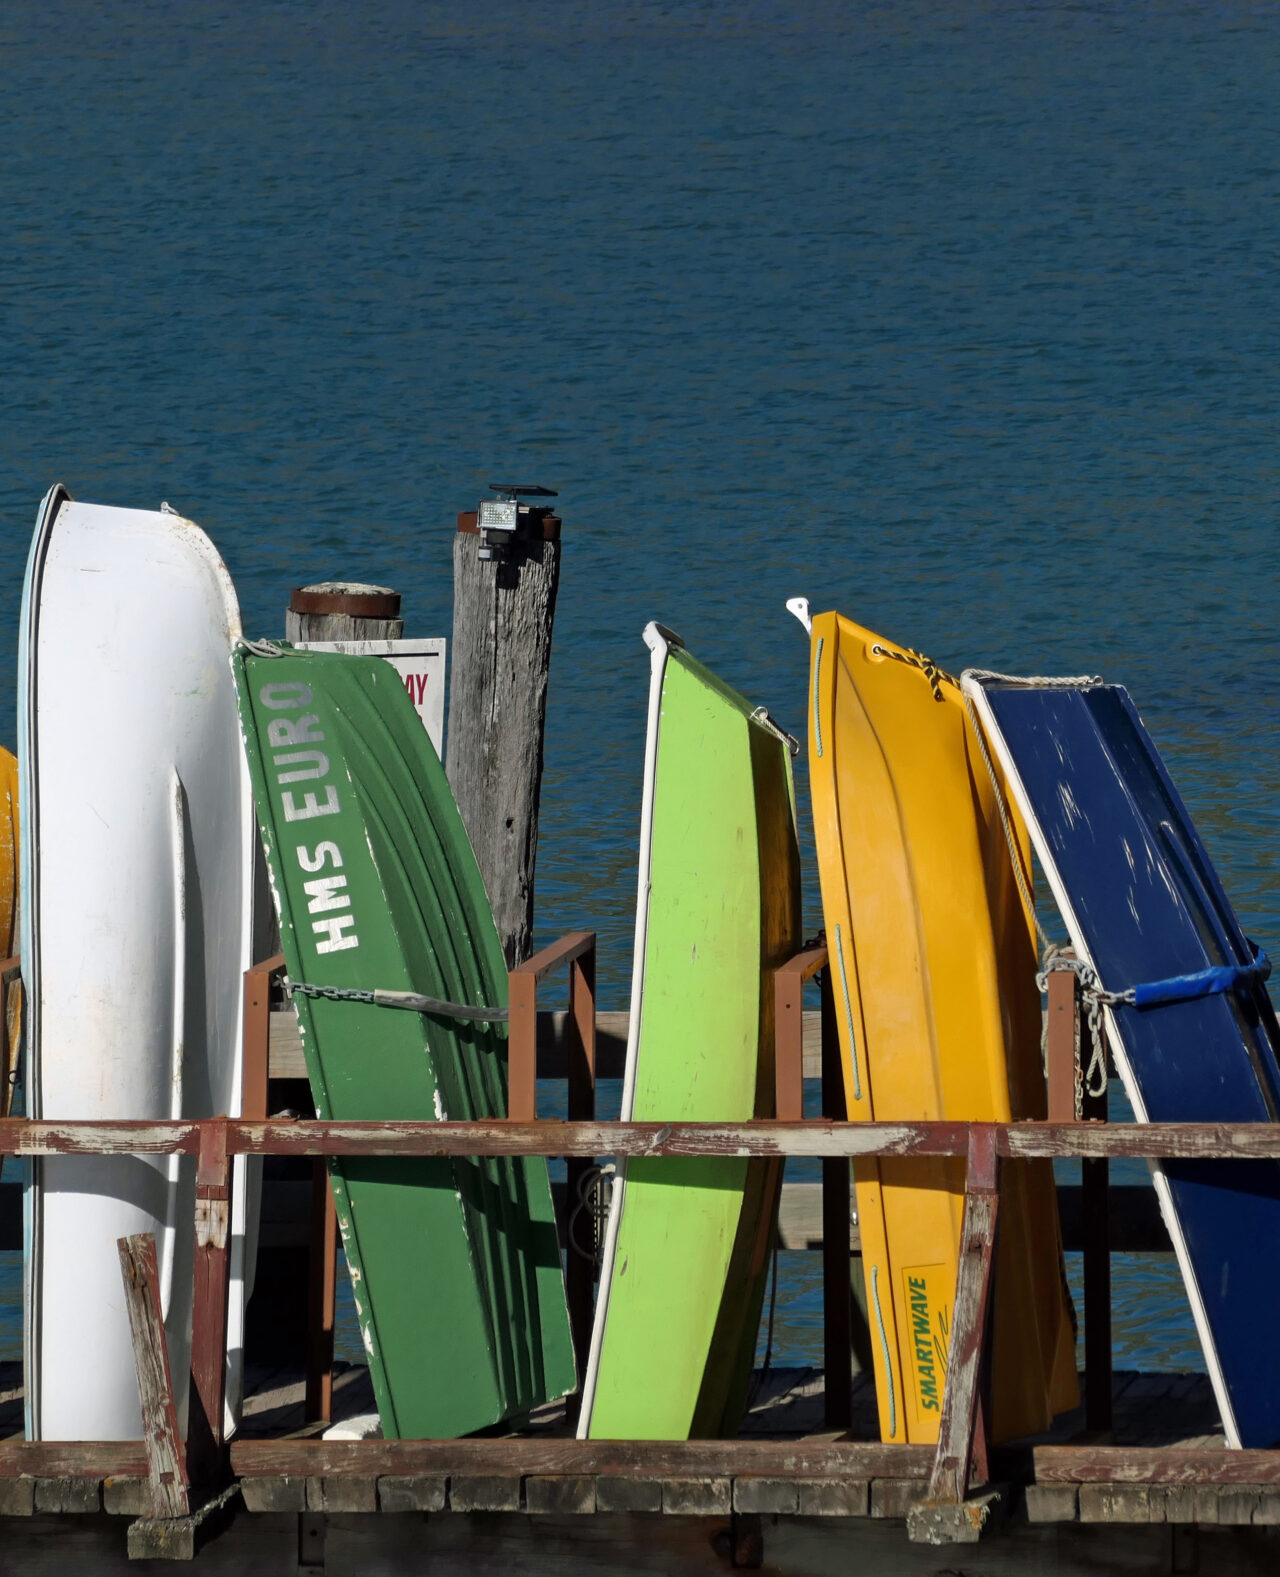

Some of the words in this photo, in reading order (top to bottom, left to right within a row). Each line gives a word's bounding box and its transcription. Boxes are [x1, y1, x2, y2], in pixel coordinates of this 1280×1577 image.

[260, 681, 341, 822] EURO
[296, 841, 359, 955] HMS
[908, 1276, 940, 1412] SMARTWAVE
